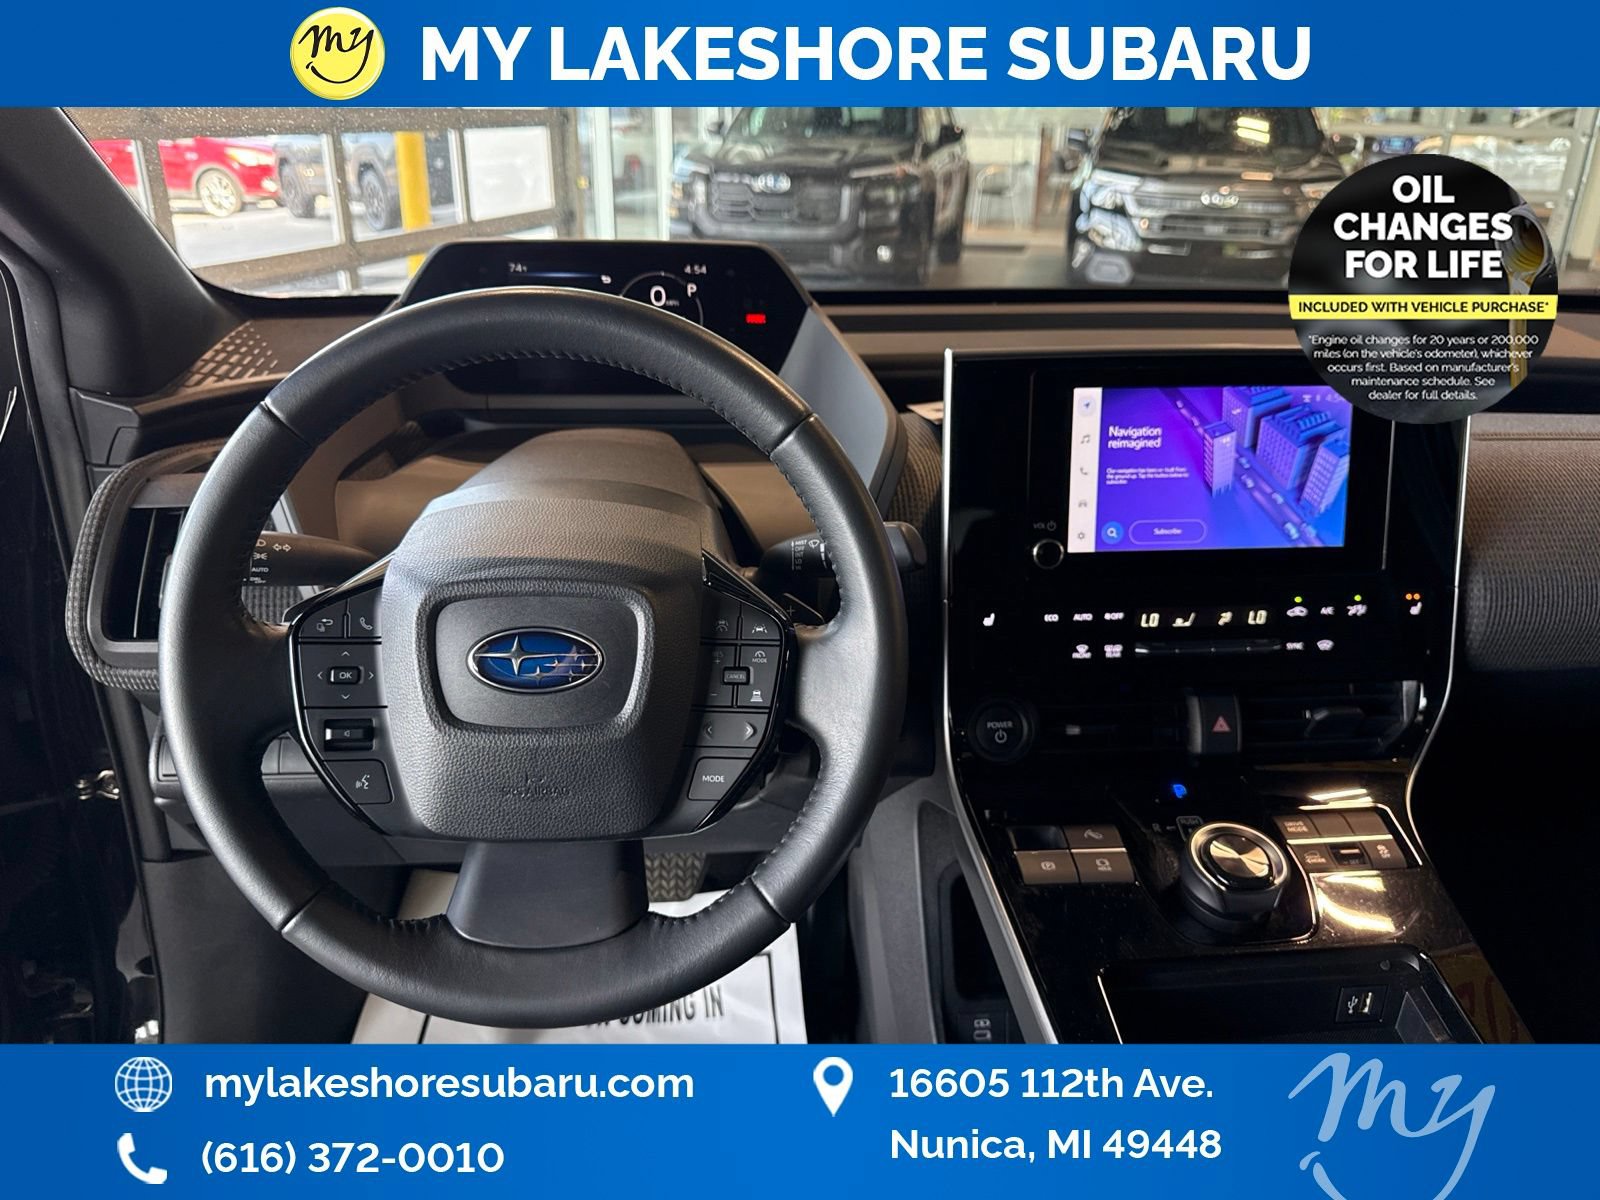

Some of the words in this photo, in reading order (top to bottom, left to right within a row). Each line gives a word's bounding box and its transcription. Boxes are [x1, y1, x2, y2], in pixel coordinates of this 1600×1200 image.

[650, 285, 666, 307] 0
[686, 283, 697, 298] P
[1108, 426, 1162, 439] Navigation
[1107, 438, 1162, 451] reimagined
[1043, 613, 1060, 622] ECO
[1073, 613, 1093, 621] AUTO
[1140, 612, 1160, 628] LO
[1247, 609, 1267, 625] LO
[339, 671, 353, 680] OK
[702, 774, 725, 783] MODE
[704, 985, 724, 1018] IN
